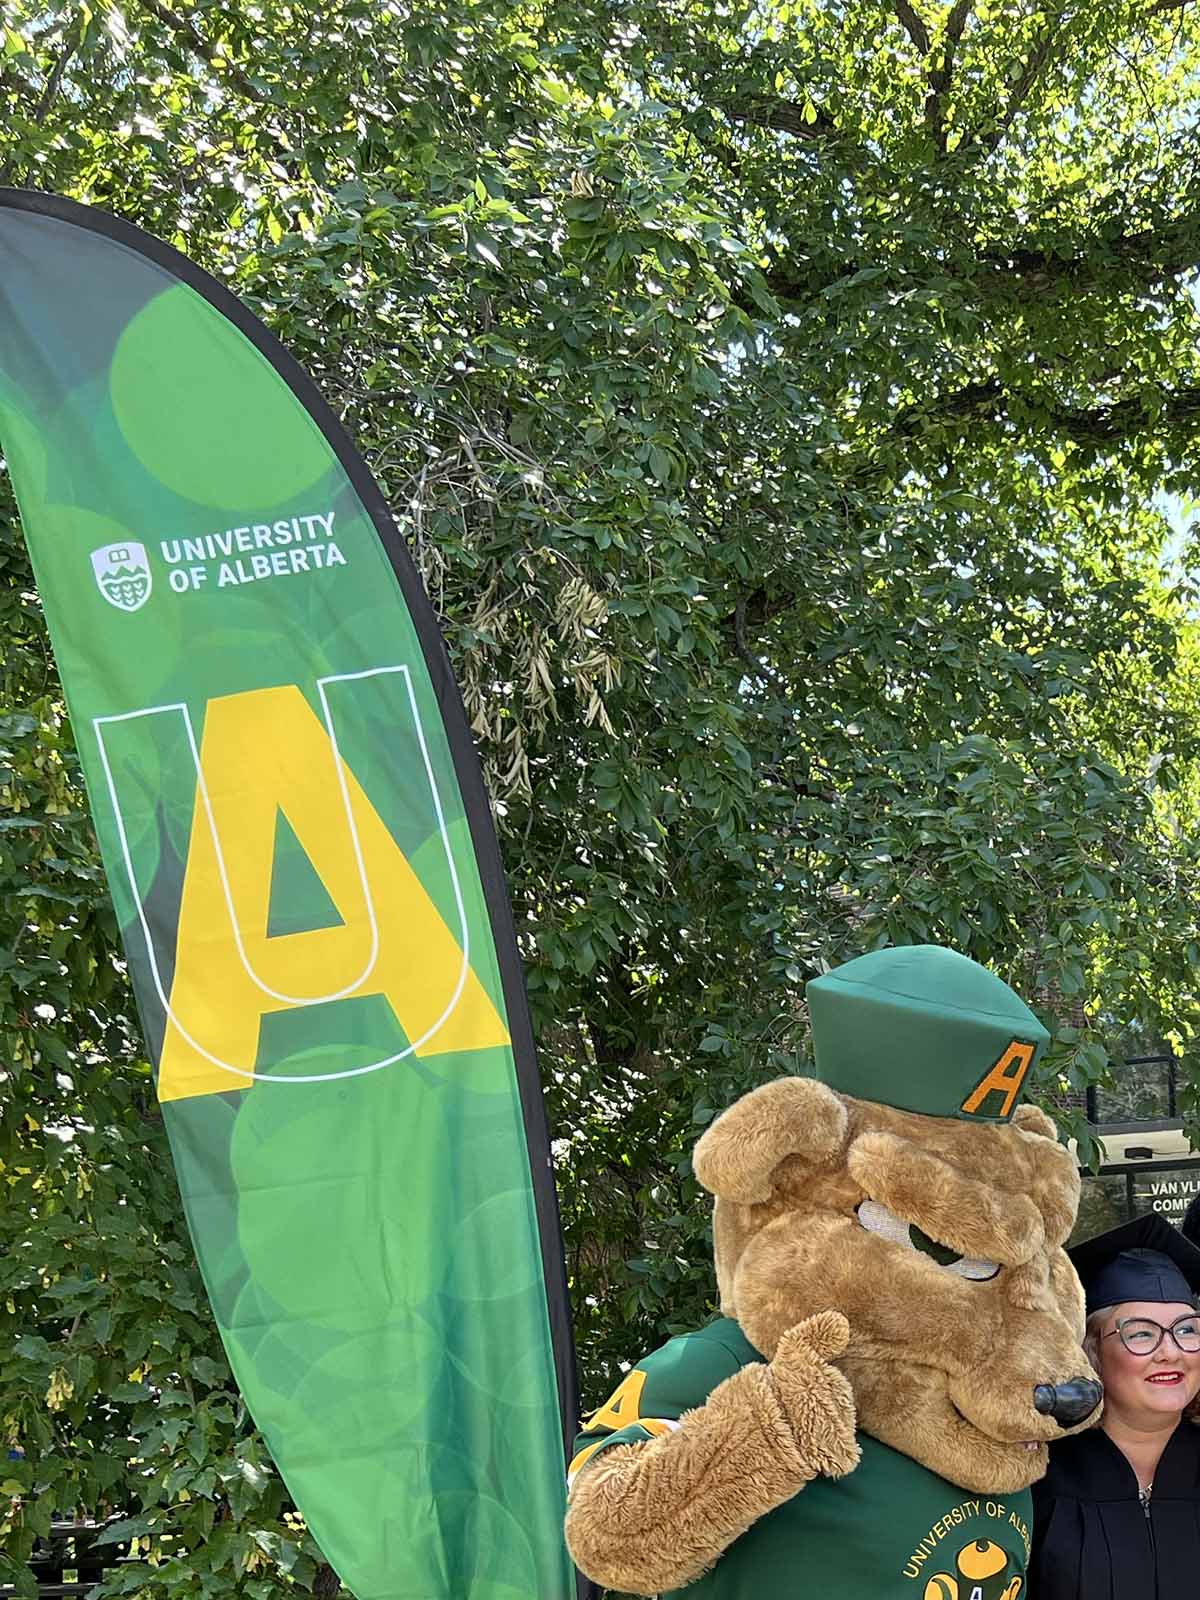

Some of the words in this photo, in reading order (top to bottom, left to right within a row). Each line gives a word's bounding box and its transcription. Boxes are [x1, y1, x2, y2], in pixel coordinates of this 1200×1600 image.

[160, 512, 336, 564] UNIVERSITY
[169, 567, 207, 593] OF
[217, 543, 347, 587] ALBERTA
[157, 685, 511, 1103] A
[962, 1040, 1035, 1117] A
[1151, 1182, 1178, 1196] VAN
[580, 1370, 648, 1431] A
[902, 1500, 980, 1579] UNIVERSITY
[985, 1501, 1006, 1518] OF
